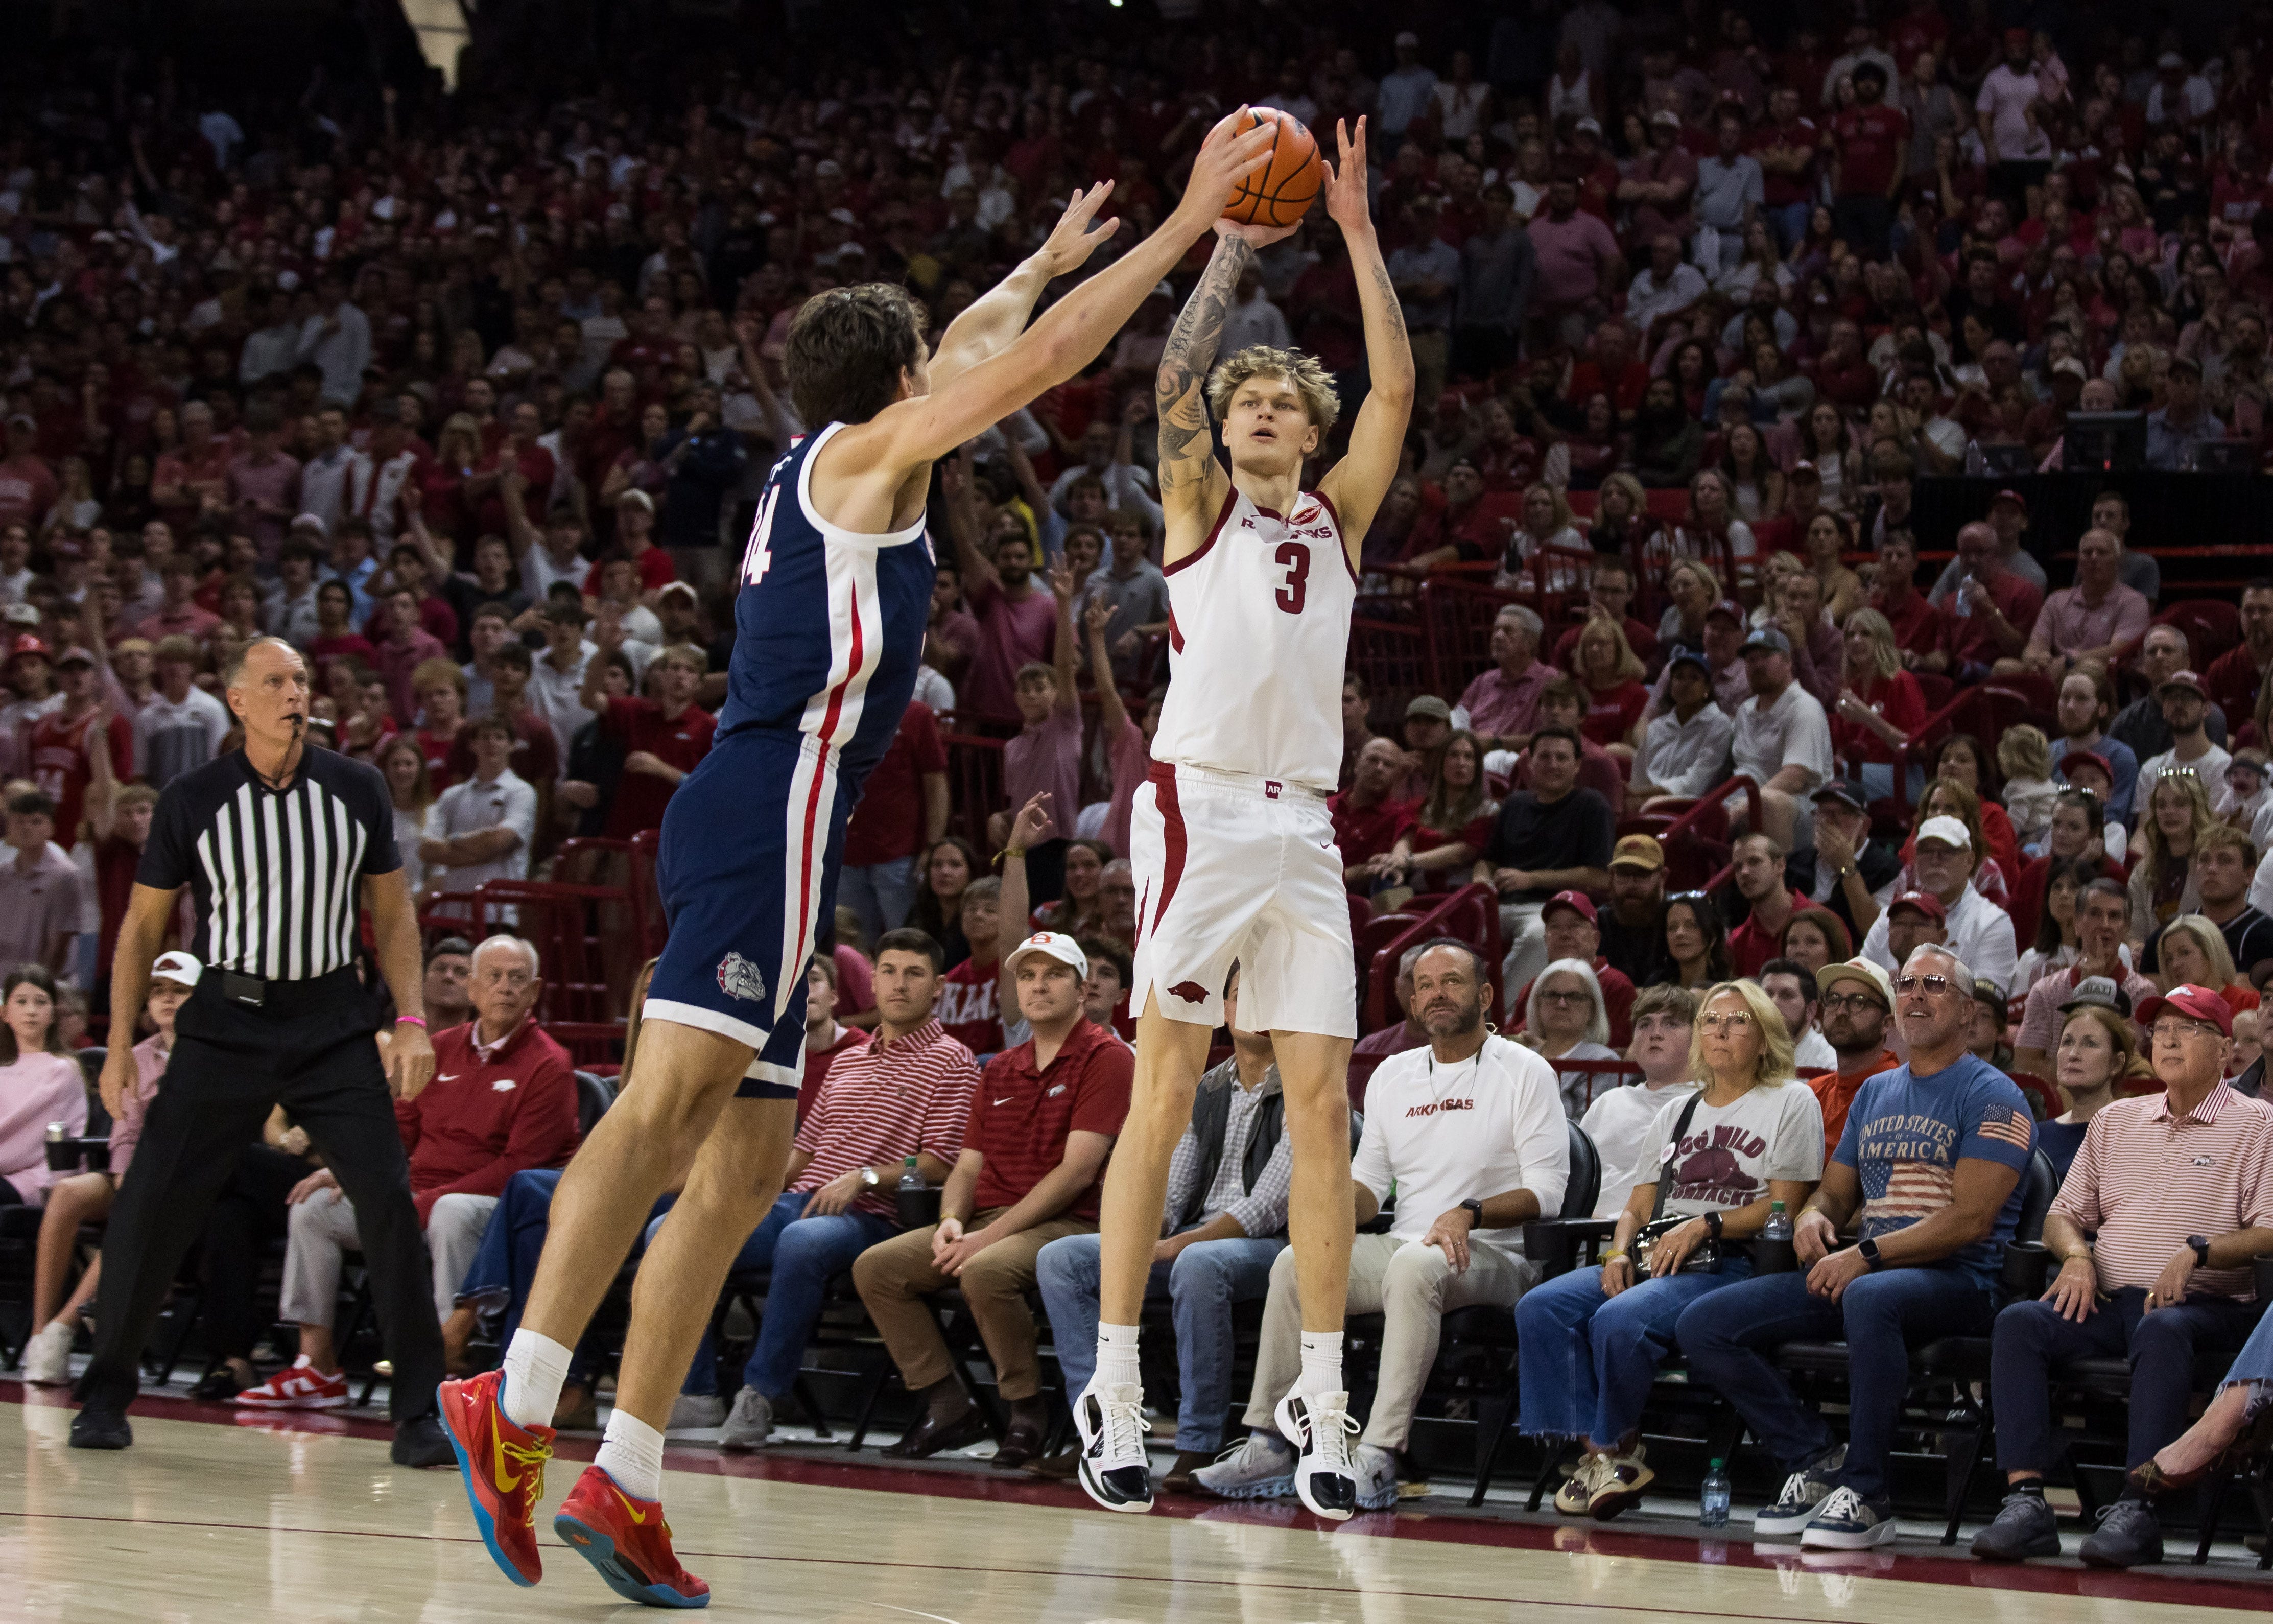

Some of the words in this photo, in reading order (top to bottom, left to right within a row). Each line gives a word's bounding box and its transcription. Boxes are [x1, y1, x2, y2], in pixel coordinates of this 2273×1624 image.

[1275, 542, 1310, 615] 3
[1267, 785, 1280, 794] AR
[1712, 1124, 1766, 1159] WILD
[1859, 1114, 1904, 1143] UNITED
[1905, 1114, 1956, 1147] STATES
[1859, 1141, 1949, 1163] AMERICA
